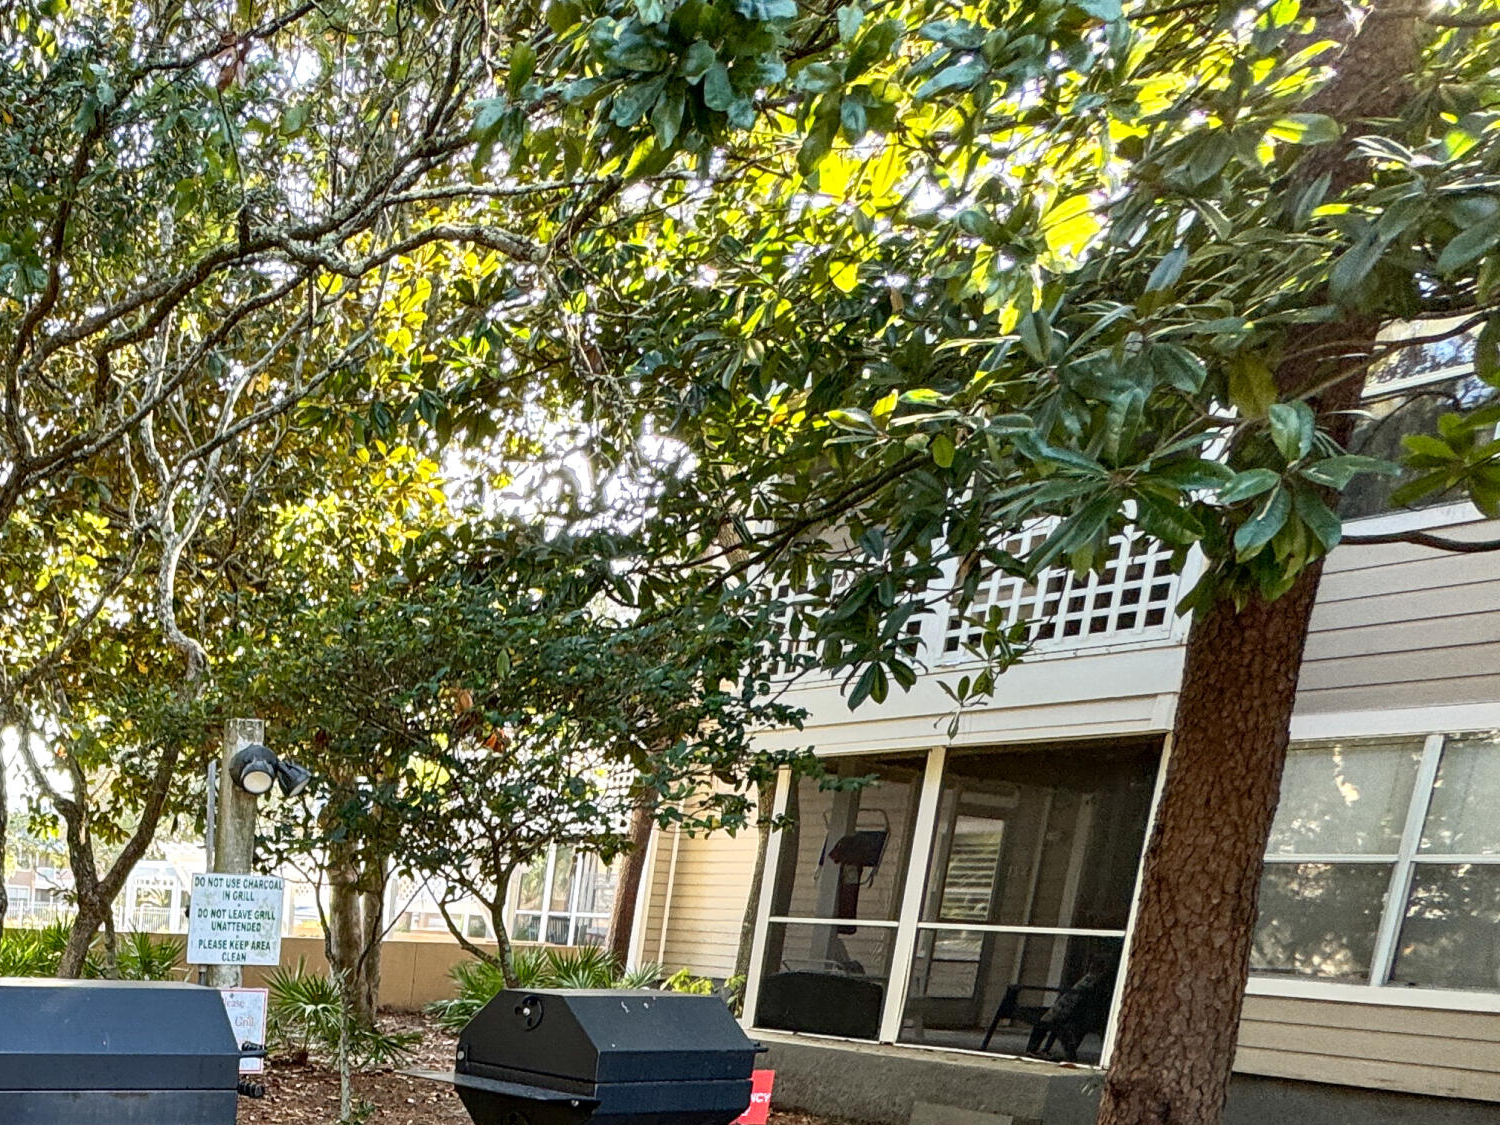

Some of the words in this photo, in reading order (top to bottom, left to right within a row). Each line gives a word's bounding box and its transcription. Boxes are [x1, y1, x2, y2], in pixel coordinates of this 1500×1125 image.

[195, 877, 205, 888] DO
[207, 877, 224, 888] NOT
[226, 878, 241, 889] USE
[243, 879, 283, 891] CHARCOAL
[222, 891, 230, 901] IN
[232, 891, 255, 902] GRILL
[197, 908, 208, 919] DO
[210, 909, 226, 919] NOT
[228, 909, 252, 920] LEAVE
[254, 910, 276, 920] GRILL
[211, 921, 261, 932] UNATTENDED
[198, 939, 227, 950] PLEASE
[229, 940, 249, 950] KEEP
[251, 941, 271, 951] AREA
[221, 952, 247, 962] CLEAN
